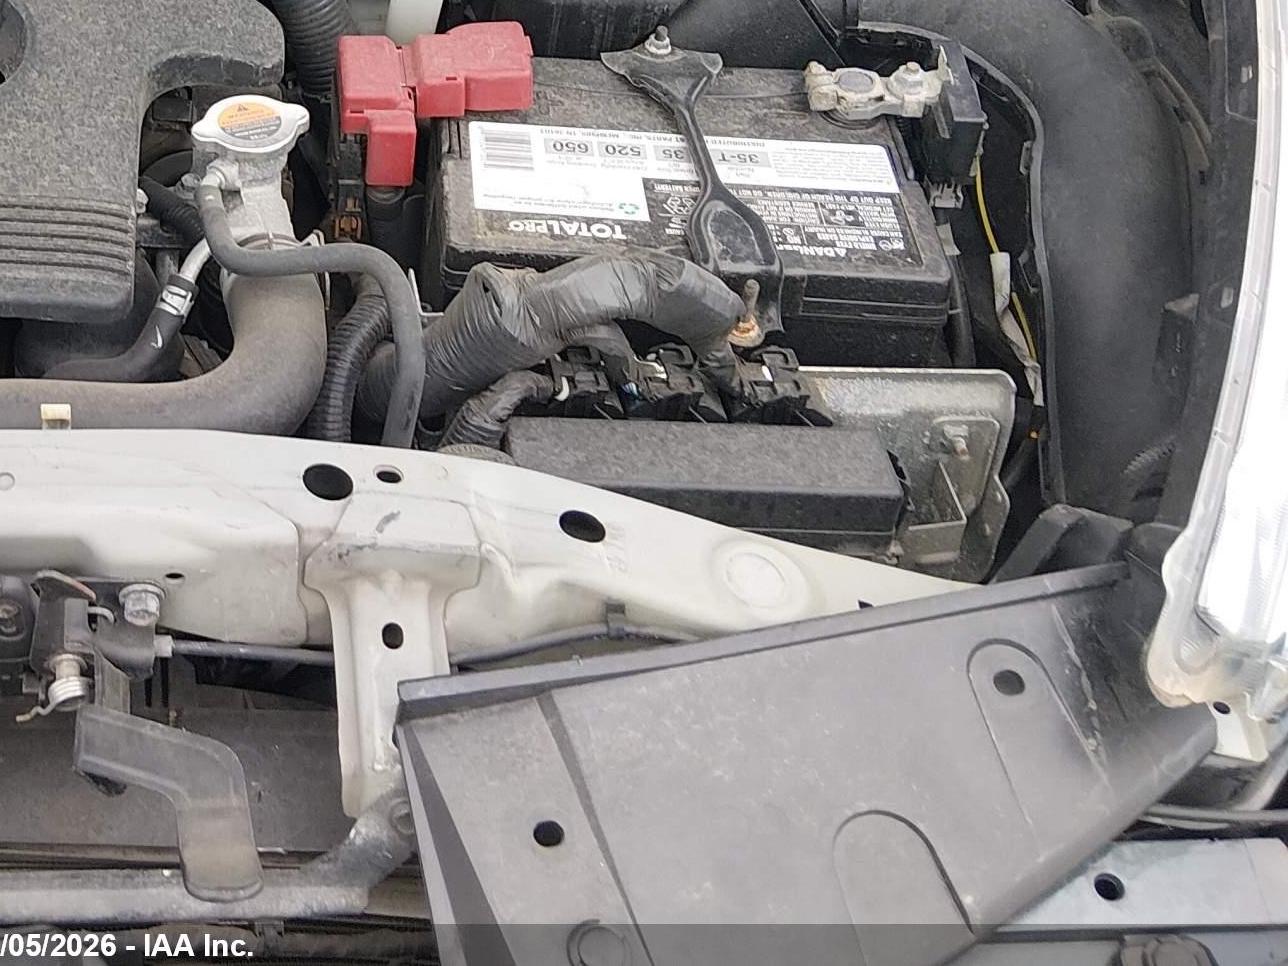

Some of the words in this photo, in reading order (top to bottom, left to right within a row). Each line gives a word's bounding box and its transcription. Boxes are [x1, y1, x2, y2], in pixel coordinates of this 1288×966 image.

[553, 141, 589, 154] 650
[605, 144, 641, 157] 520
[662, 149, 684, 160] 35
[718, 152, 759, 164] 35-T
[509, 218, 627, 240] TOTALPRO
